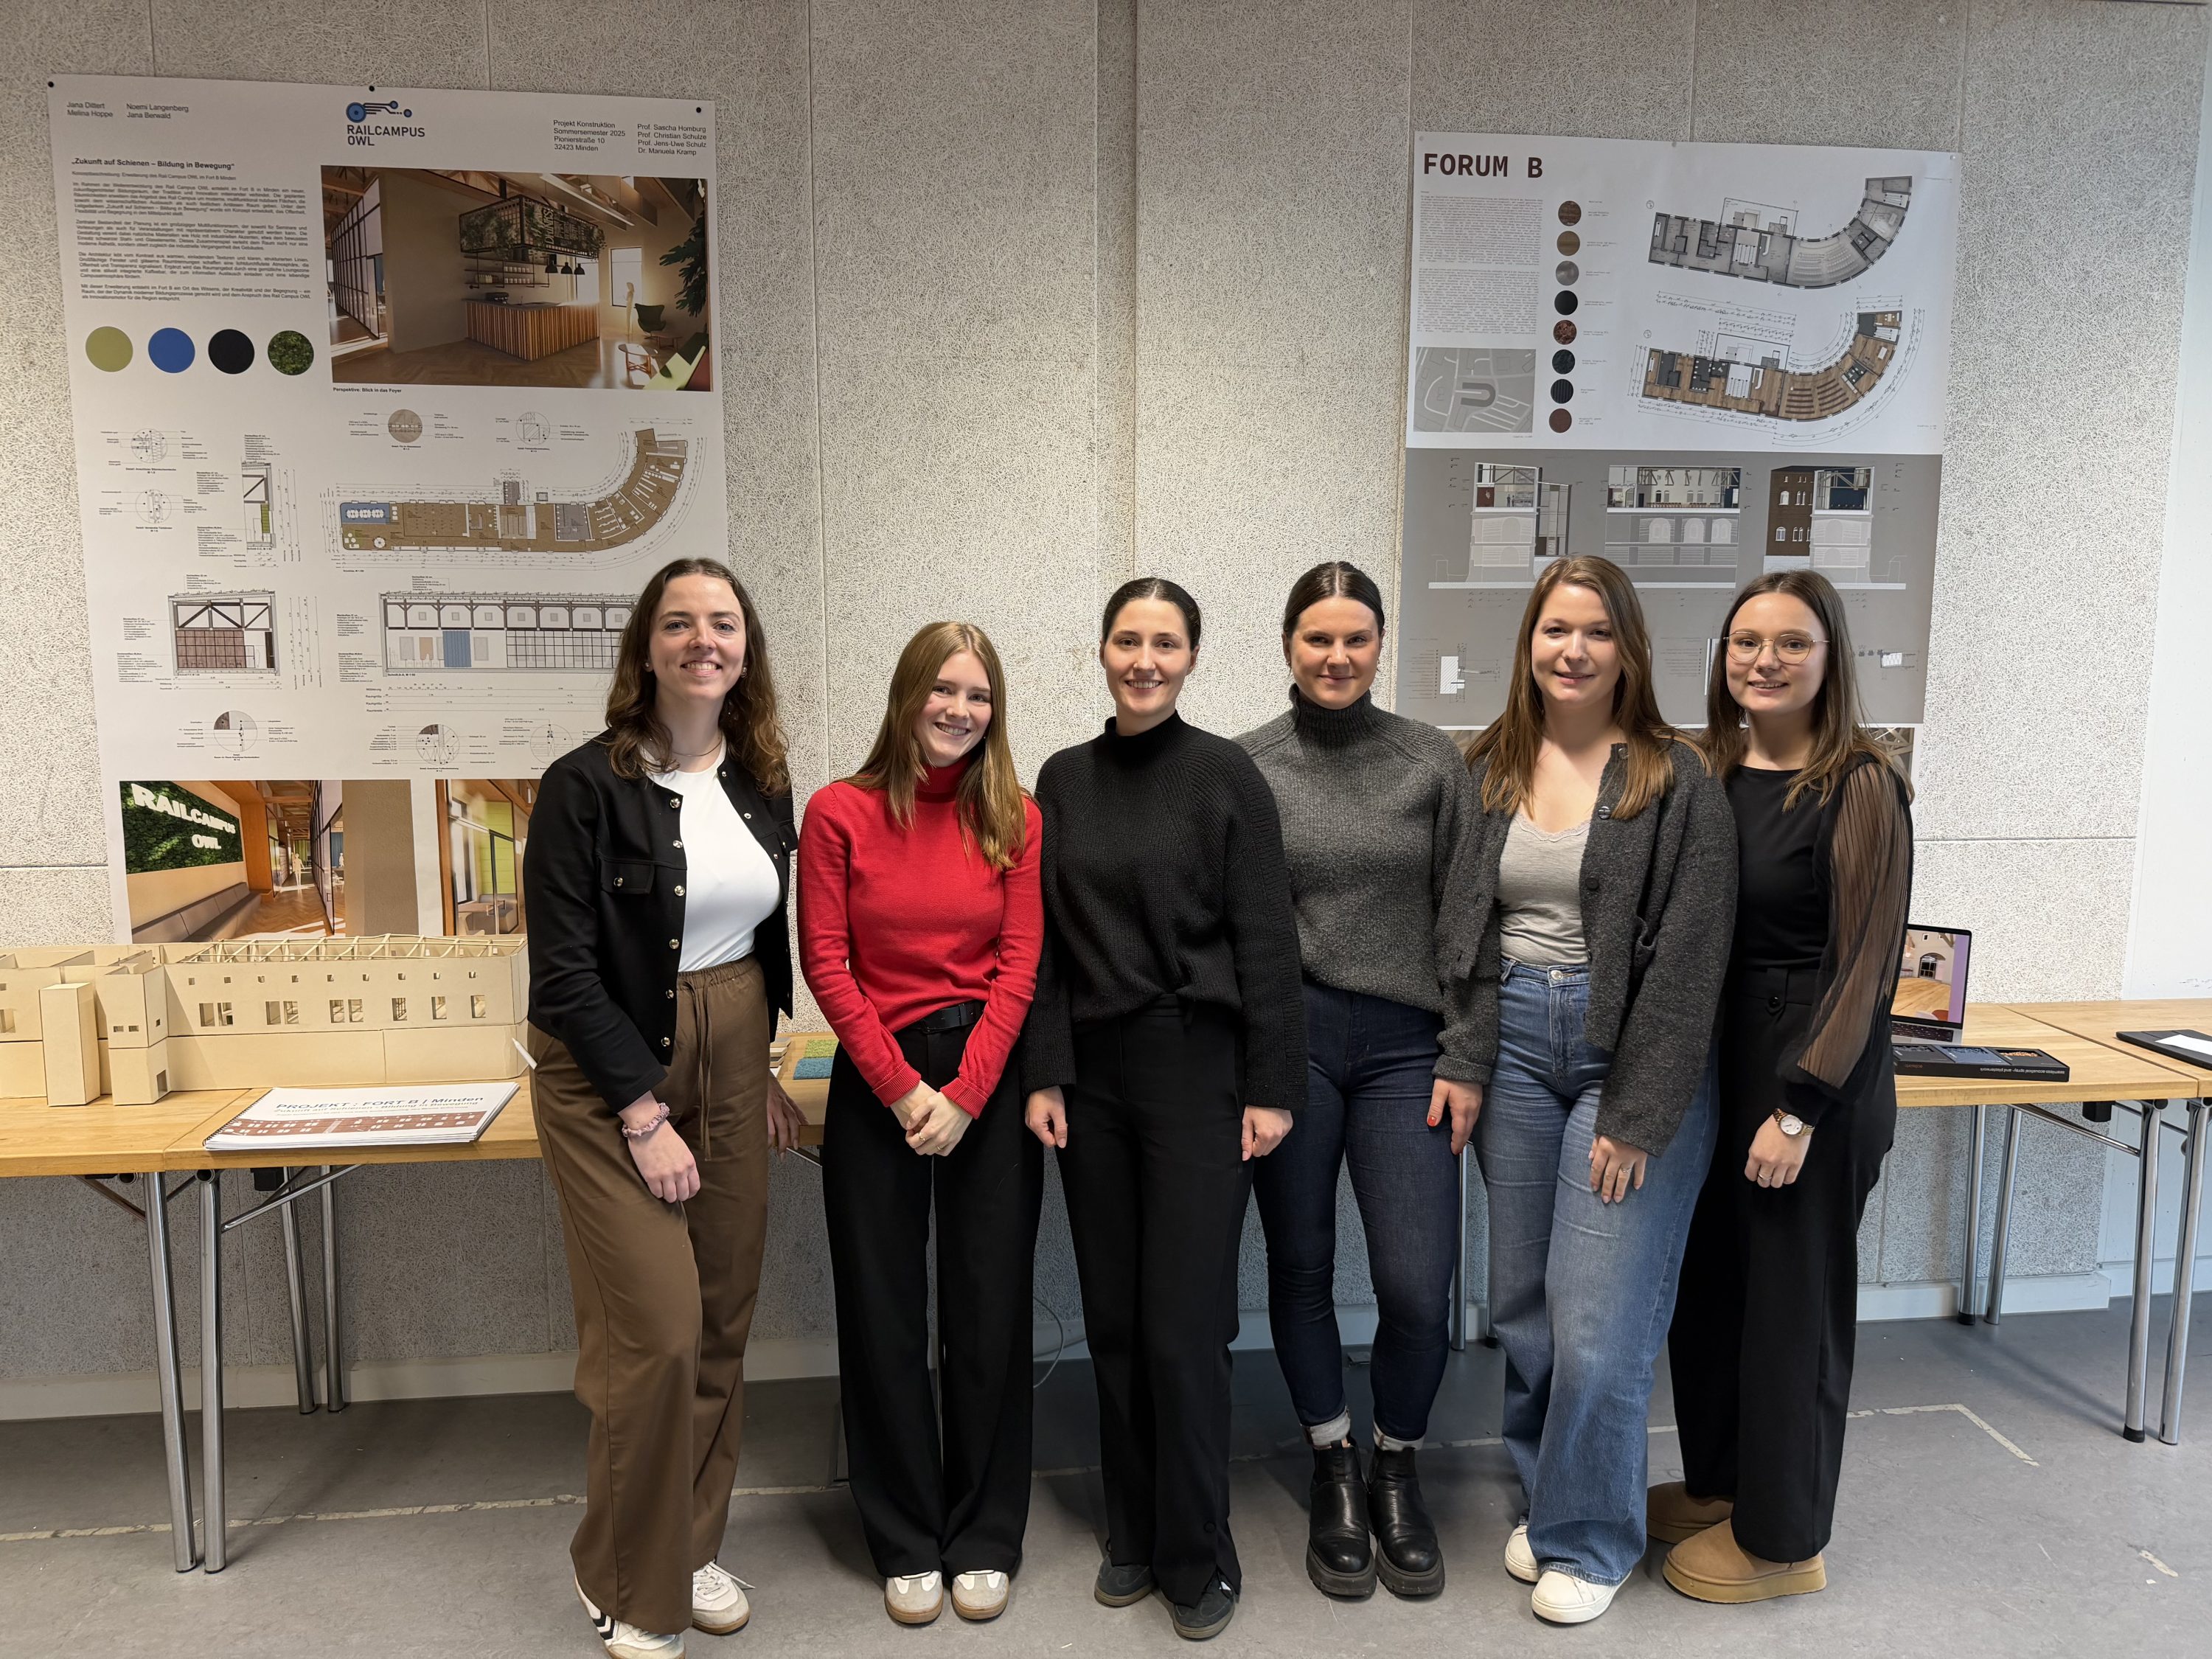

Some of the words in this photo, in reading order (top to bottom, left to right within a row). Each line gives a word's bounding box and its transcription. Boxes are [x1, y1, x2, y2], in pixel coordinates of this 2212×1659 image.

[149, 103, 189, 113] Langenberg
[347, 125, 425, 137] RAILCAMPUS
[348, 136, 375, 146] OWL
[554, 136, 595, 144] Pionierstraße
[157, 161, 184, 169] Bildung
[1424, 153, 1508, 177] FORUM
[1528, 157, 1543, 178] B
[131, 783, 236, 835] RAILCAMPUS
[192, 834, 221, 849] OWL
